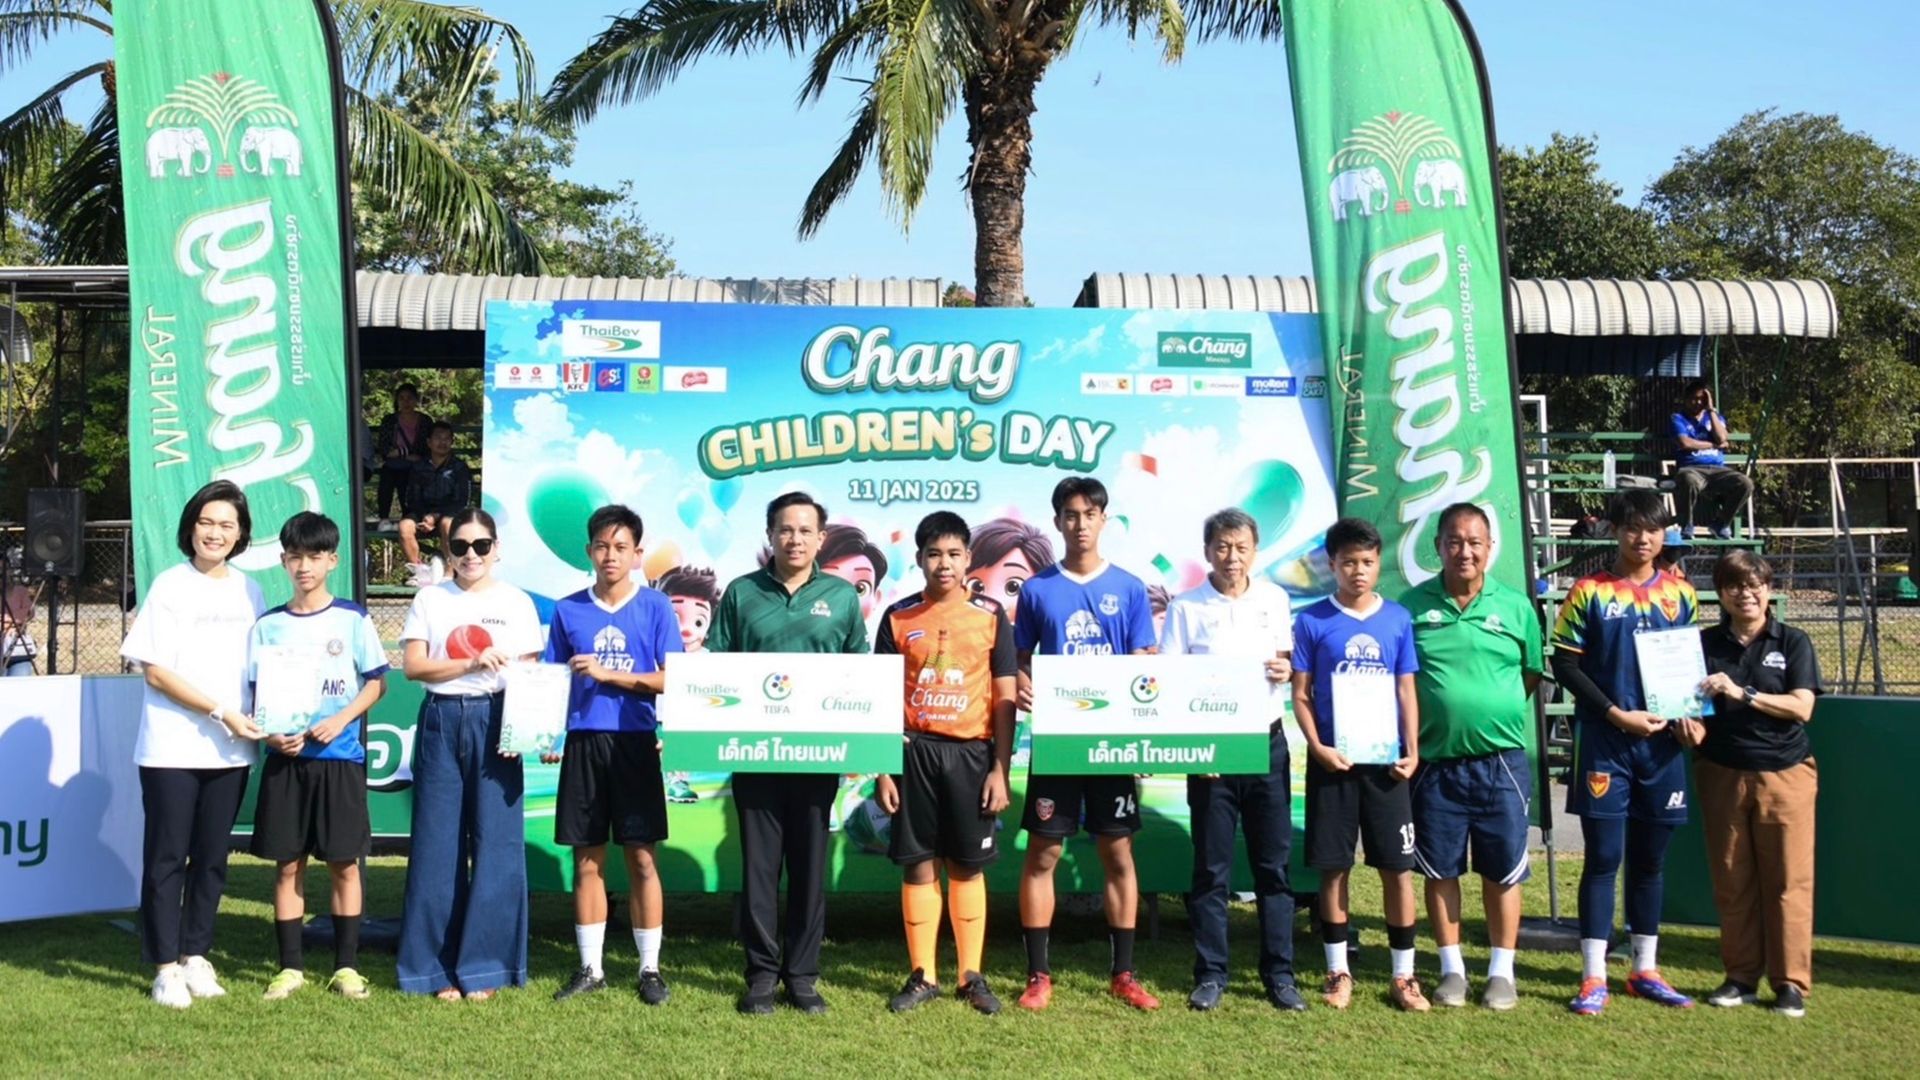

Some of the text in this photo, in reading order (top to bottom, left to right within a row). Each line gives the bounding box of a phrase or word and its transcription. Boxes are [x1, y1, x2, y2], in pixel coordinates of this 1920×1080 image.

[580, 325, 640, 336] ThaiBev
[1188, 336, 1247, 358] Chang
[803, 325, 1021, 400] Chang
[1252, 379, 1289, 389] molten
[701, 408, 1114, 475] CHILDREN's DAY
[849, 480, 978, 505] 11 JAN 2025
[321, 678, 346, 696] ANG
[686, 684, 739, 694] ThaiBev
[1054, 687, 1107, 697] ThaiBev
[821, 696, 872, 713] Chang
[911, 687, 968, 712] Chang
[1188, 699, 1238, 715] Chang
[763, 705, 790, 714] TBFA
[1132, 707, 1159, 716] TBFA
[771, 737, 848, 761] ไทยเบฟ
[1140, 740, 1216, 763] ไทยเบฟ
[1114, 793, 1136, 818] 24
